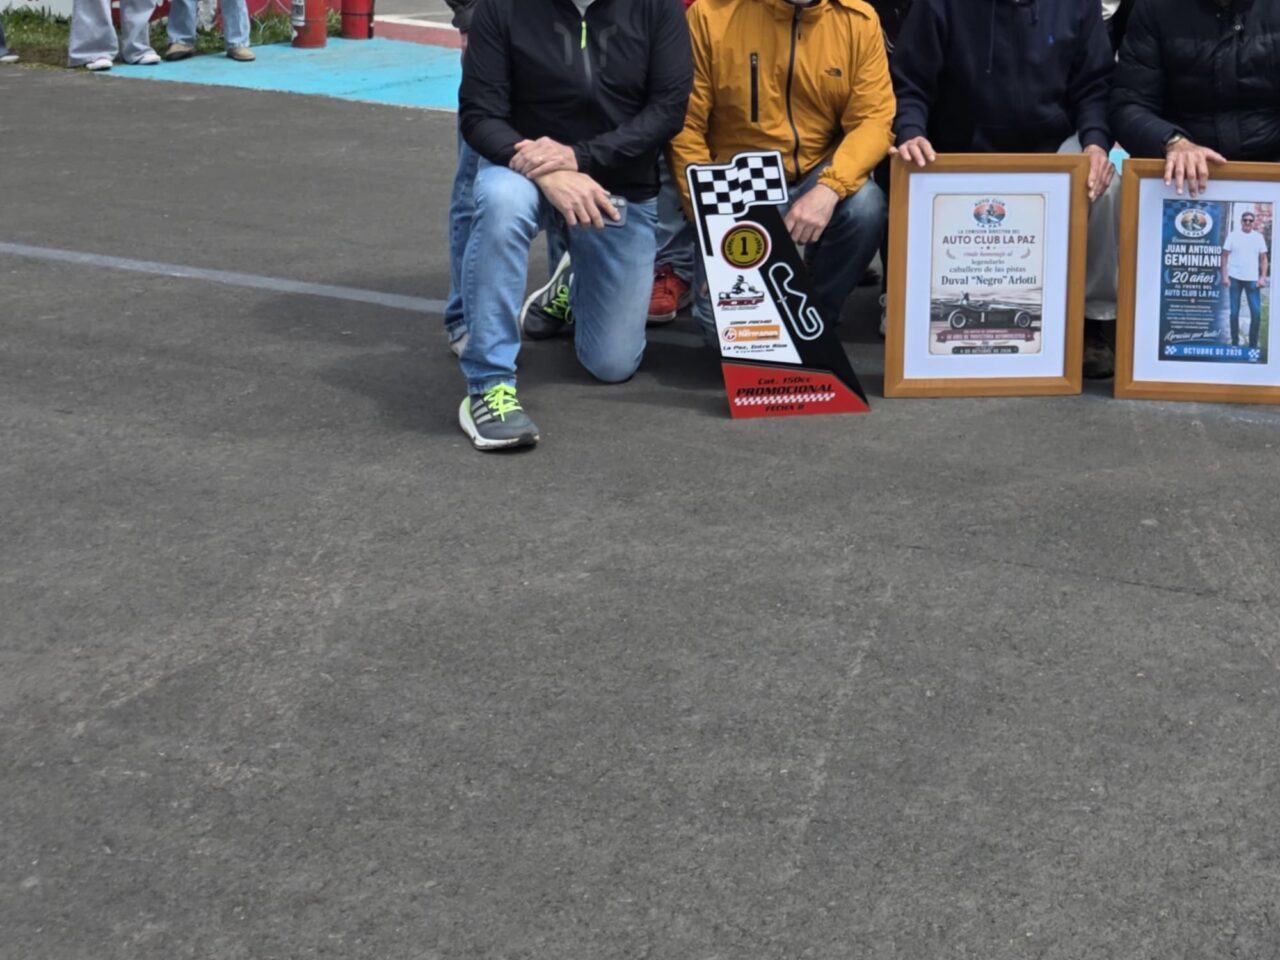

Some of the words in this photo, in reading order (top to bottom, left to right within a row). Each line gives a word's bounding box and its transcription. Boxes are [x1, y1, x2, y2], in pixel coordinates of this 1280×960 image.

[942, 235, 971, 245] AUTO
[973, 235, 1000, 245] CLUB
[1003, 235, 1015, 245] LA
[1017, 235, 1036, 244] PAZ
[740, 236, 749, 256] 1
[1165, 244, 1187, 253] JUAN
[1188, 245, 1222, 254] ANTONIO
[1164, 255, 1222, 267] GEMINIANI
[1006, 266, 1026, 275] pistas
[941, 275, 969, 286] Duval
[1008, 275, 1037, 285] Arlotti
[1172, 271, 1189, 283] 20
[1189, 273, 1215, 284] años
[1164, 289, 1181, 297] AUTO
[1181, 289, 1197, 297] CLUB
[1198, 289, 1207, 298] LA
[1208, 289, 1220, 298] PAZ
[1183, 347, 1213, 356] OCTUBRE
[1215, 348, 1224, 356] DE
[735, 383, 835, 397] PROMOCIONAL
